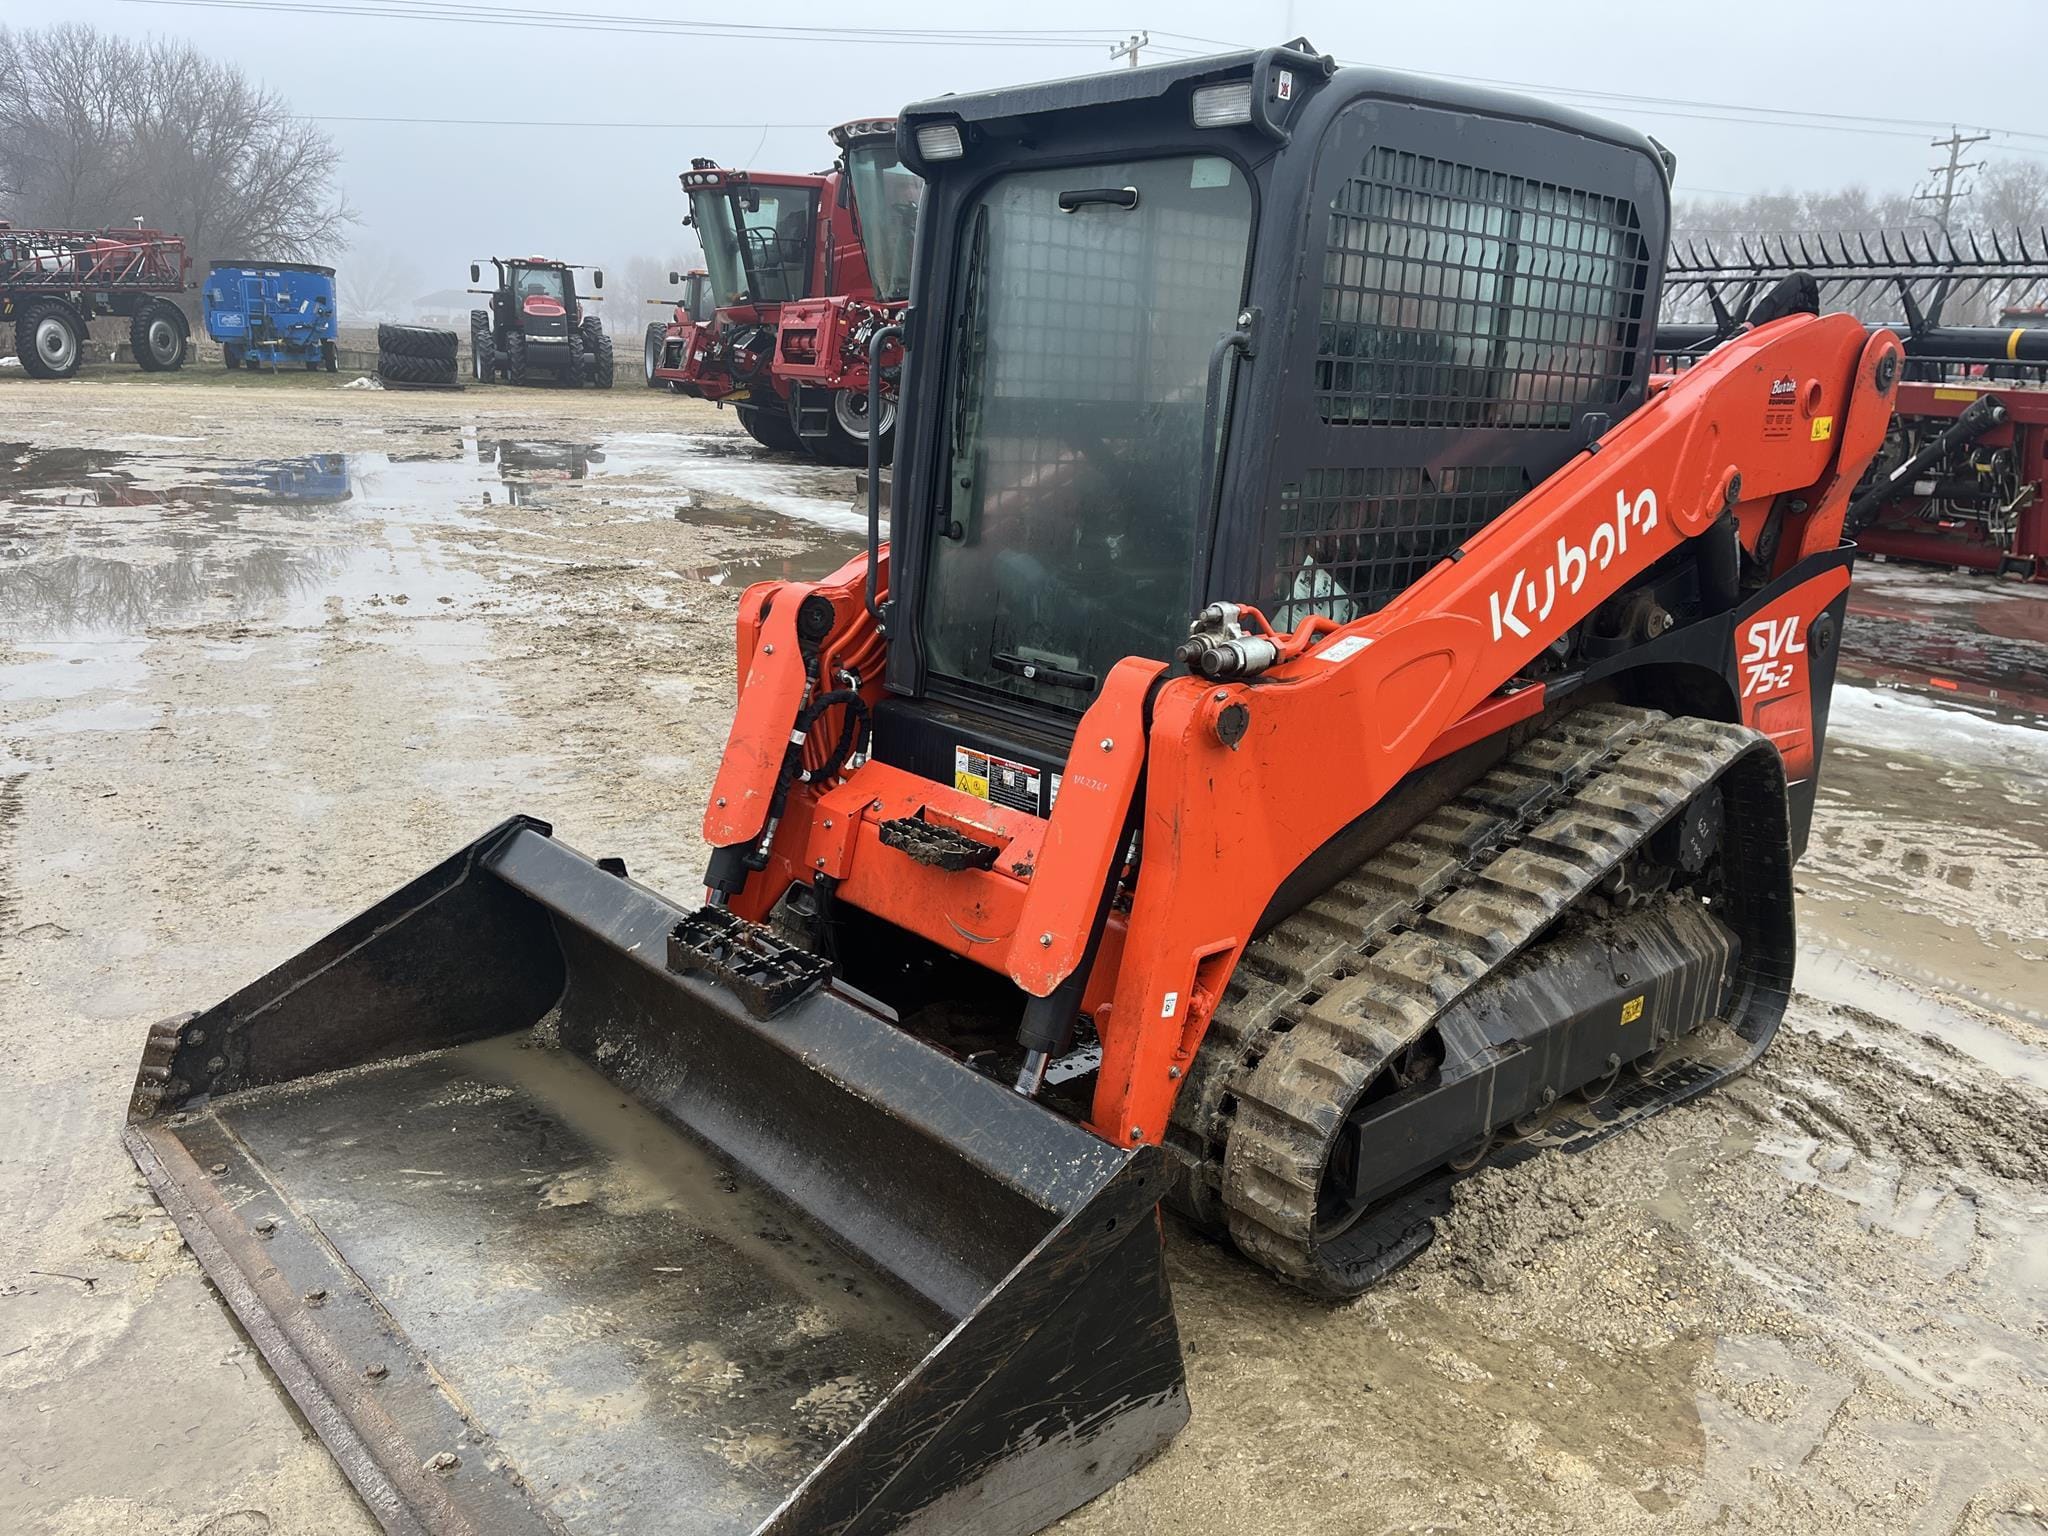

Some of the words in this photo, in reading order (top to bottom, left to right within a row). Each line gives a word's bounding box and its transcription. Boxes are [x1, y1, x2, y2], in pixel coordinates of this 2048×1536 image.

[1489, 488, 1658, 642] Kubota
[1741, 615, 1805, 664] SVL
[1742, 660, 1794, 698] 75-2
